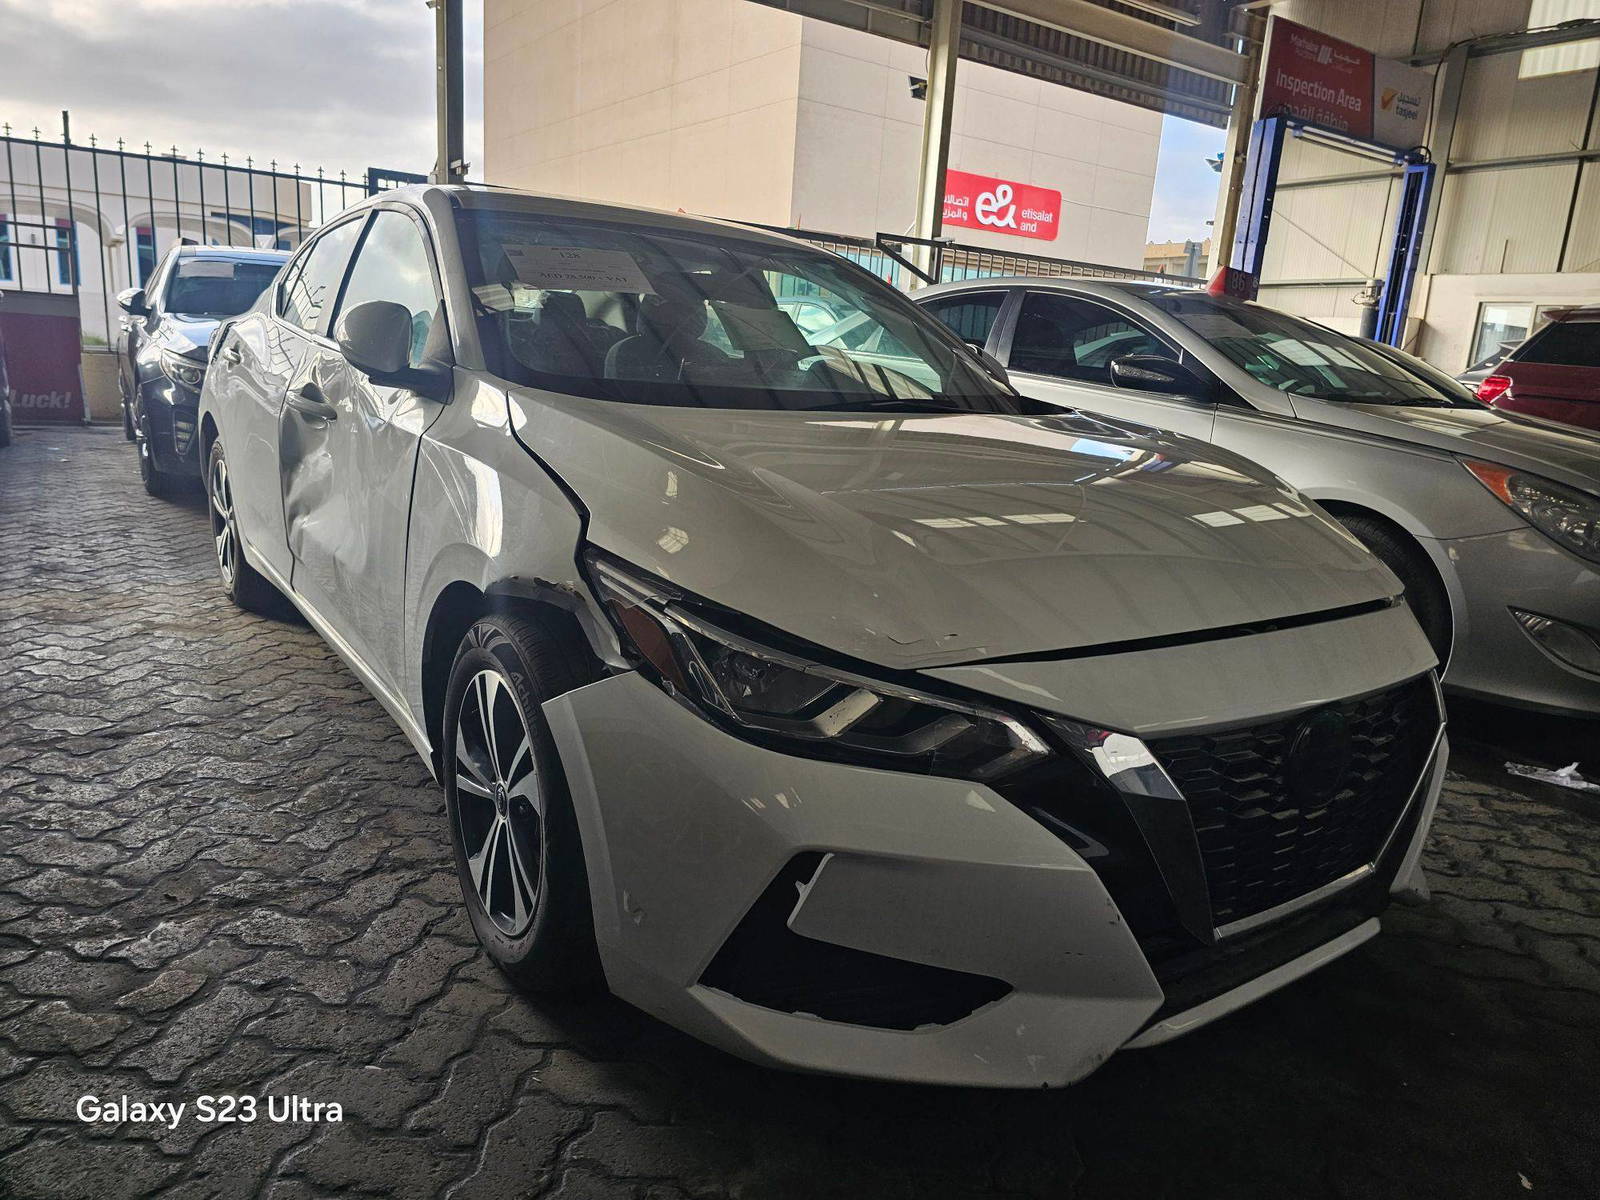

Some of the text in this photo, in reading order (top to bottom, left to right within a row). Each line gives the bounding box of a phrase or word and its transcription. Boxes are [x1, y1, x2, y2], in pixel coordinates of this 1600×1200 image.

[1276, 68, 1362, 111] Inspection Area
[1396, 105, 1418, 120] tasjeel
[944, 193, 969, 207] اتصالا
[943, 208, 968, 222] والمزي
[1021, 208, 1053, 223] etisalat
[1020, 222, 1037, 232] and
[9, 389, 72, 408] Luck!
